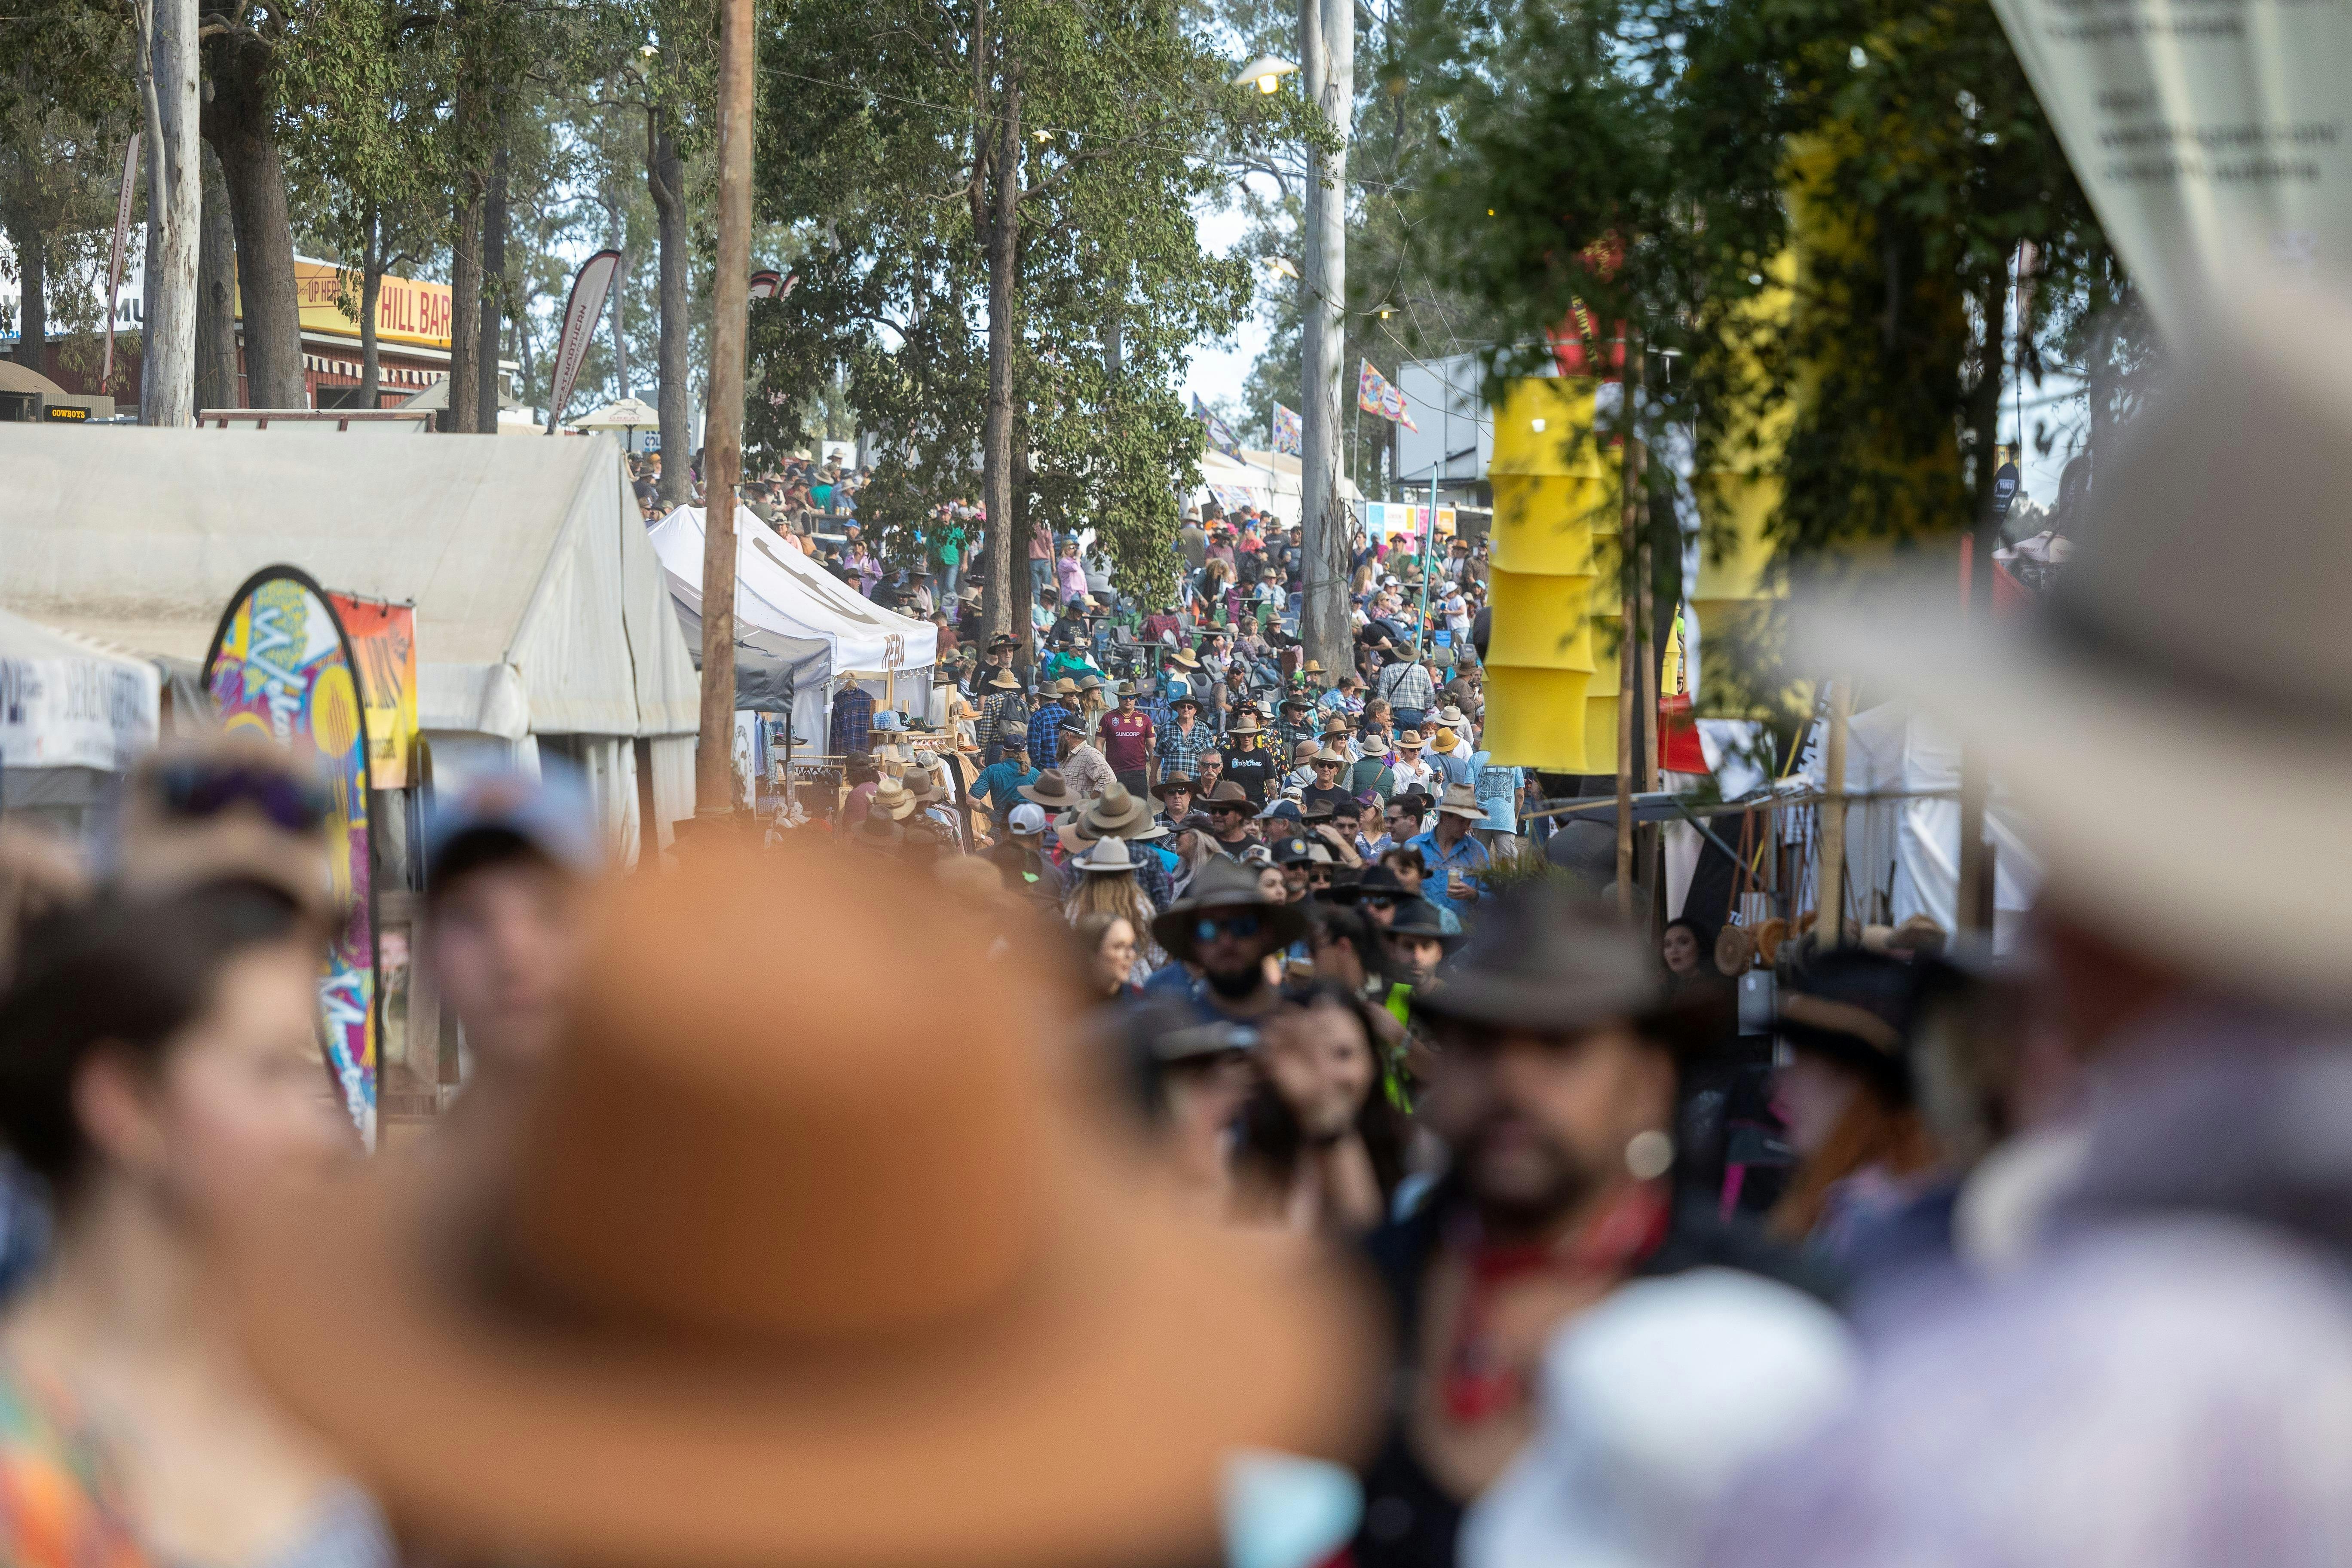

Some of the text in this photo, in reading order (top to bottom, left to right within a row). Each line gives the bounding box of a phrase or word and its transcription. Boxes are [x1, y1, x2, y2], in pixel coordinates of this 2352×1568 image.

[309, 281, 319, 303] UP
[381, 285, 415, 332] HILL
[420, 291, 450, 337] BAR
[52, 409, 85, 418] COWBOYS
